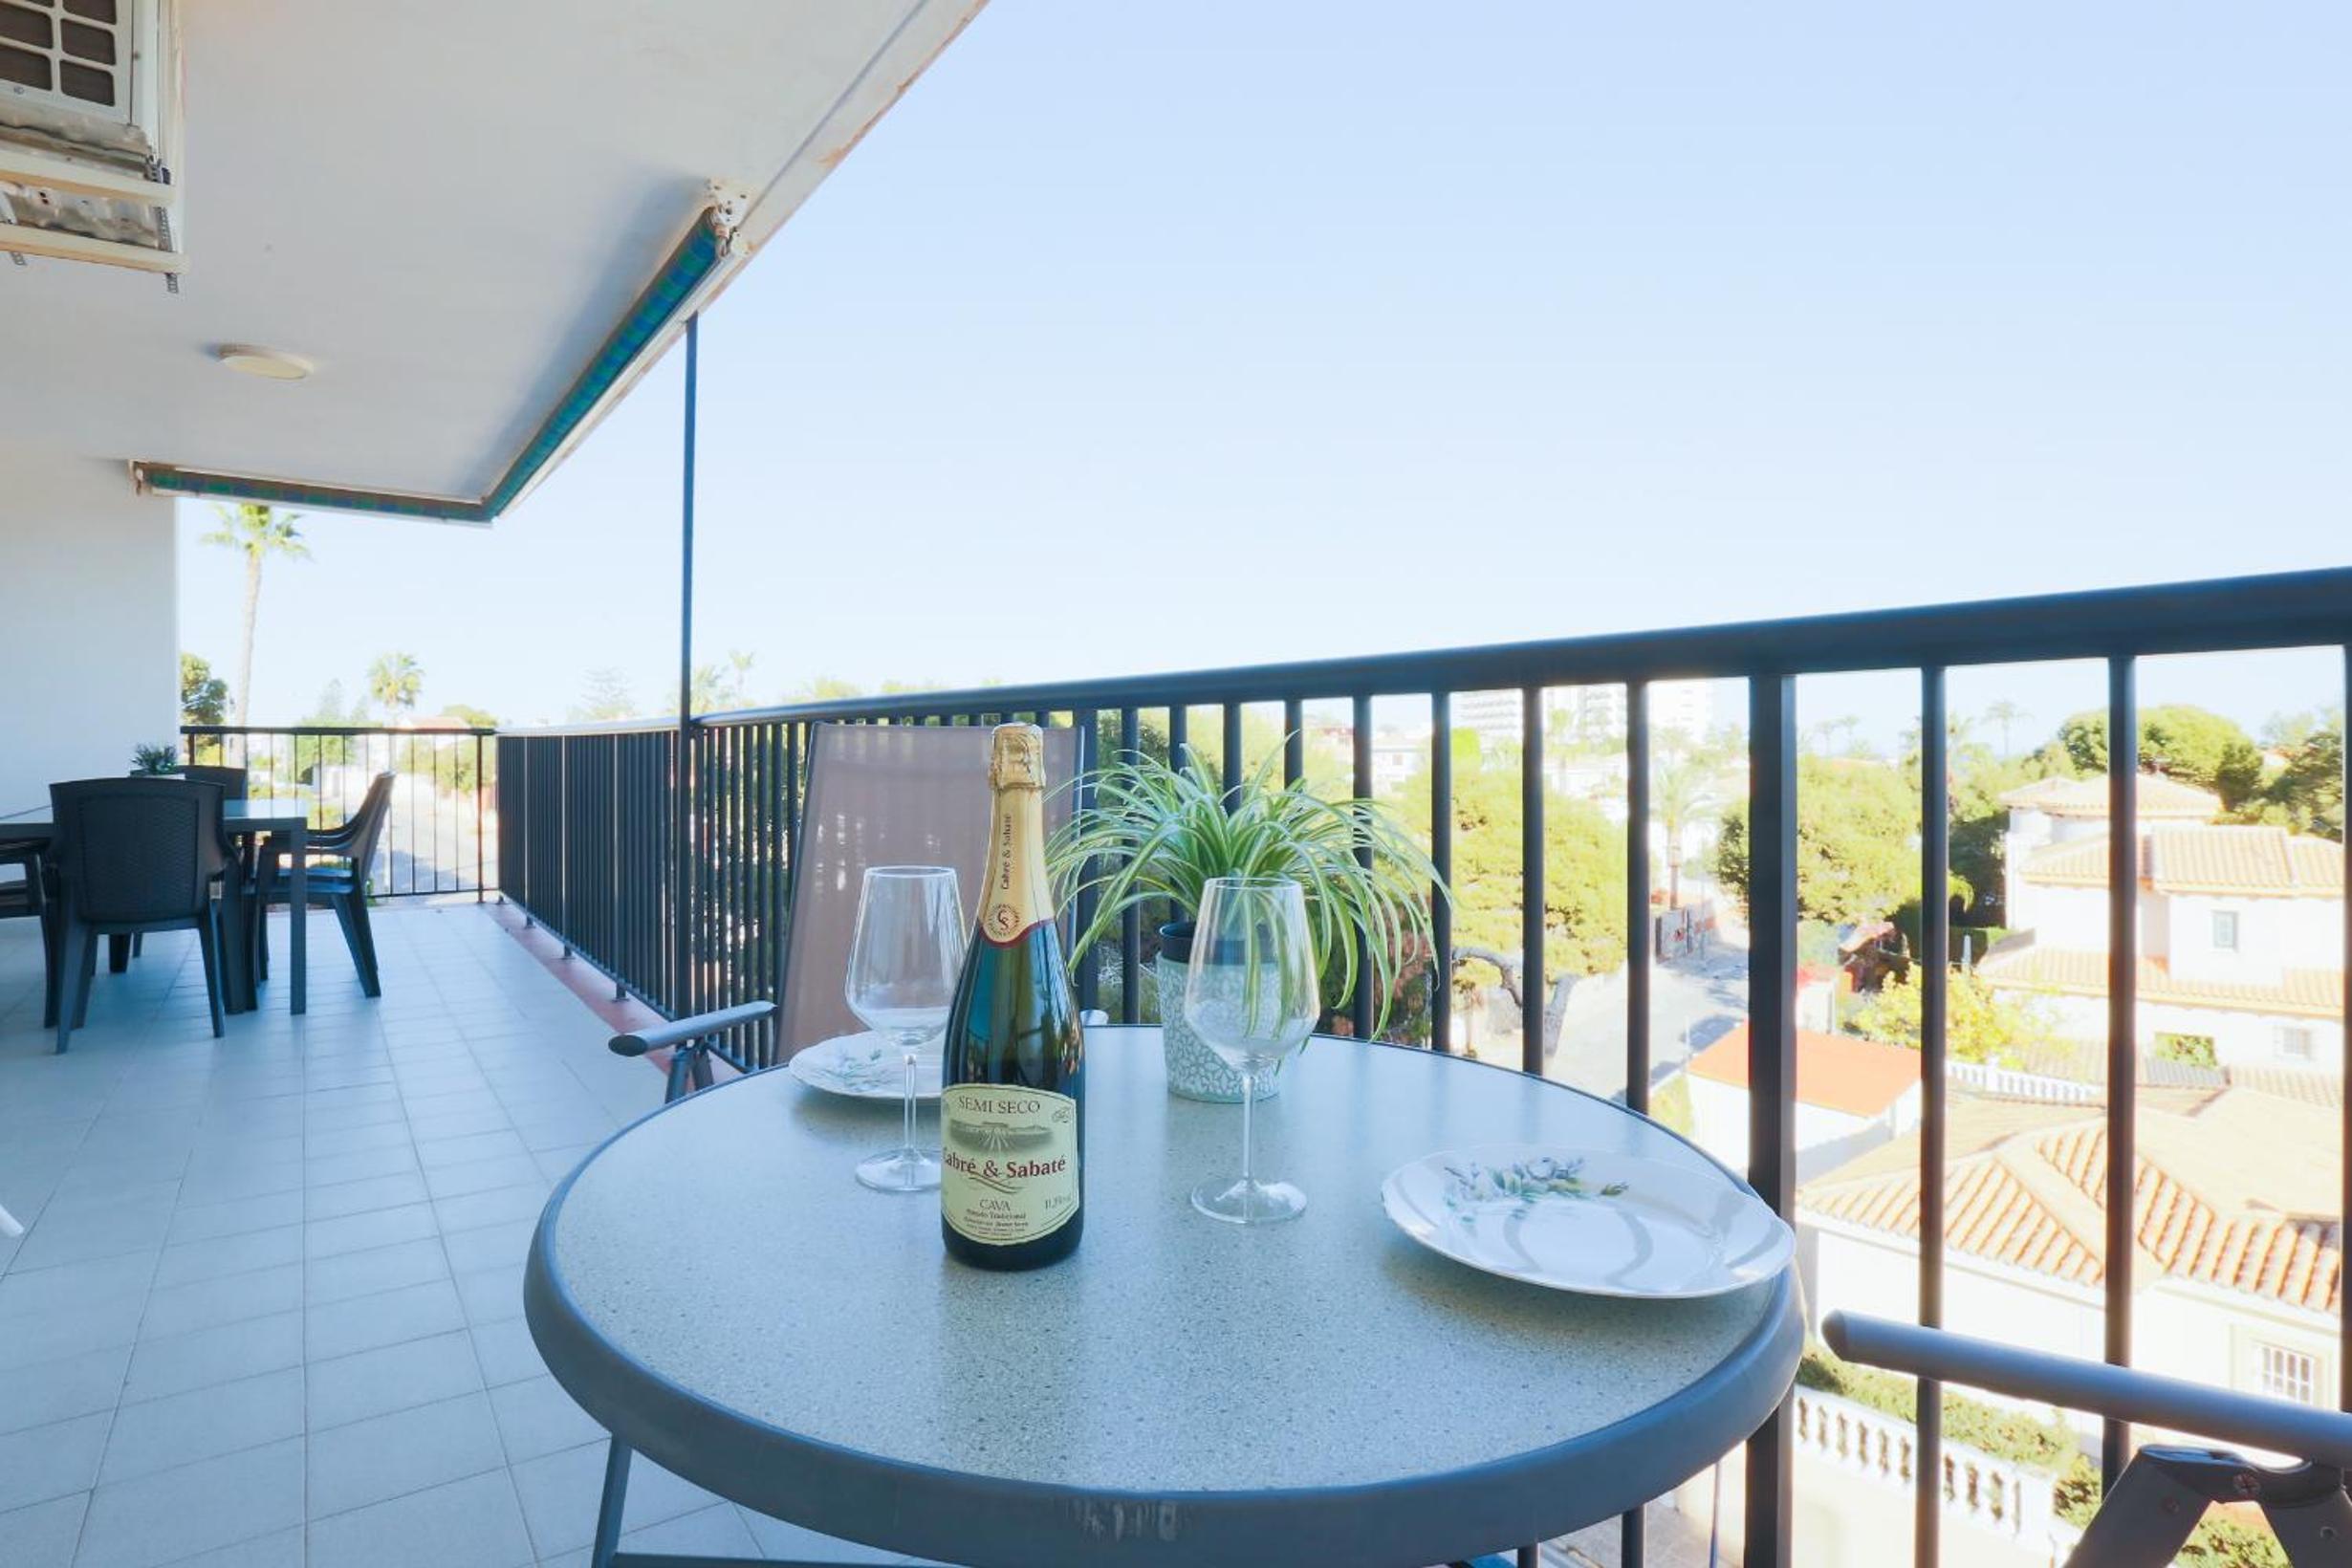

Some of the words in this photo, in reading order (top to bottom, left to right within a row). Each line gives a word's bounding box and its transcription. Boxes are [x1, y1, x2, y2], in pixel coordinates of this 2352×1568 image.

[1002, 849, 1011, 858] &
[958, 1095, 992, 1113] SEMI
[997, 1100, 1040, 1114] SECO
[983, 1160, 998, 1178] &
[1007, 1155, 1066, 1178] Sabaté
[979, 1198, 1011, 1211] CAVA
